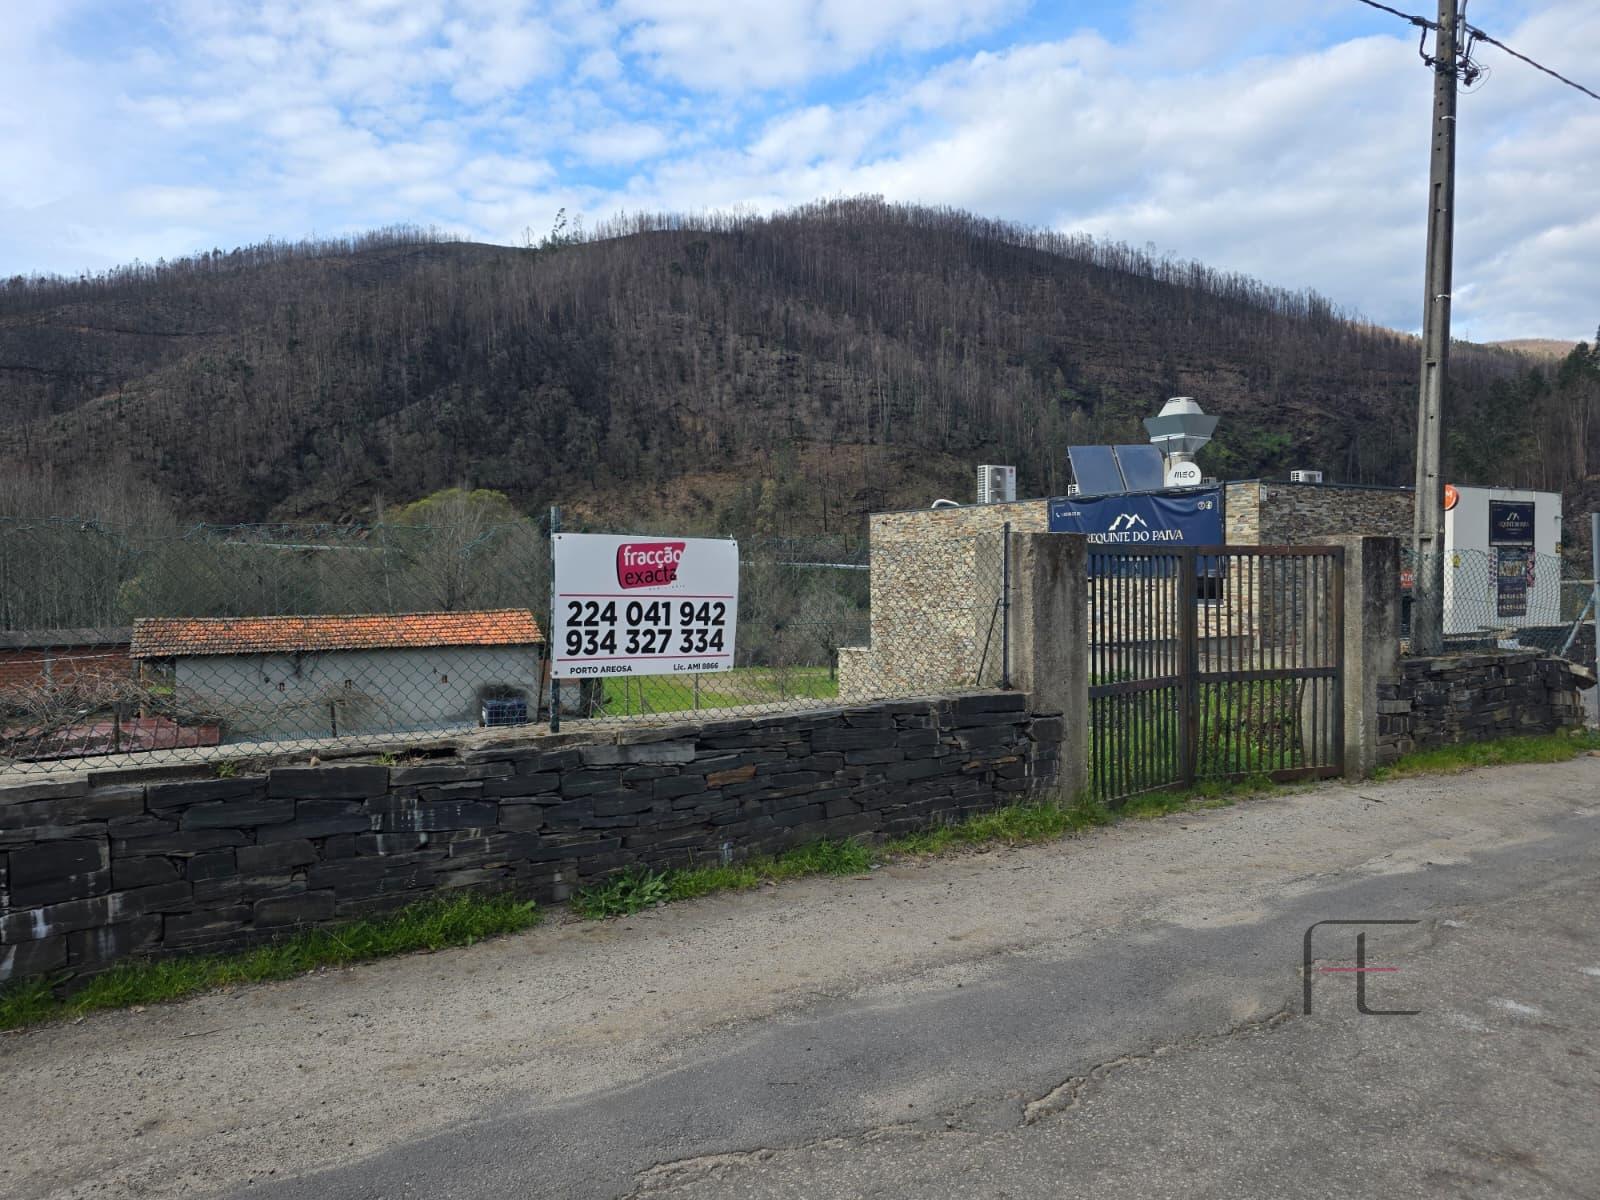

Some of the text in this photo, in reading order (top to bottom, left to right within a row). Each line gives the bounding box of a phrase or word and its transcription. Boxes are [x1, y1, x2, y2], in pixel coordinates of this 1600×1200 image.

[1174, 470, 1196, 479] MEO
[1133, 531, 1149, 542] DO
[1152, 529, 1183, 541] PAIVA
[624, 545, 683, 568] fracção
[625, 566, 677, 585] exacta
[566, 601, 726, 627] 224 041 942
[565, 628, 724, 656] 934 327 334
[570, 666, 597, 674] PORTO
[600, 665, 632, 673] AREOSA
[673, 663, 686, 671] Lic.
[687, 663, 701, 671] AMI
